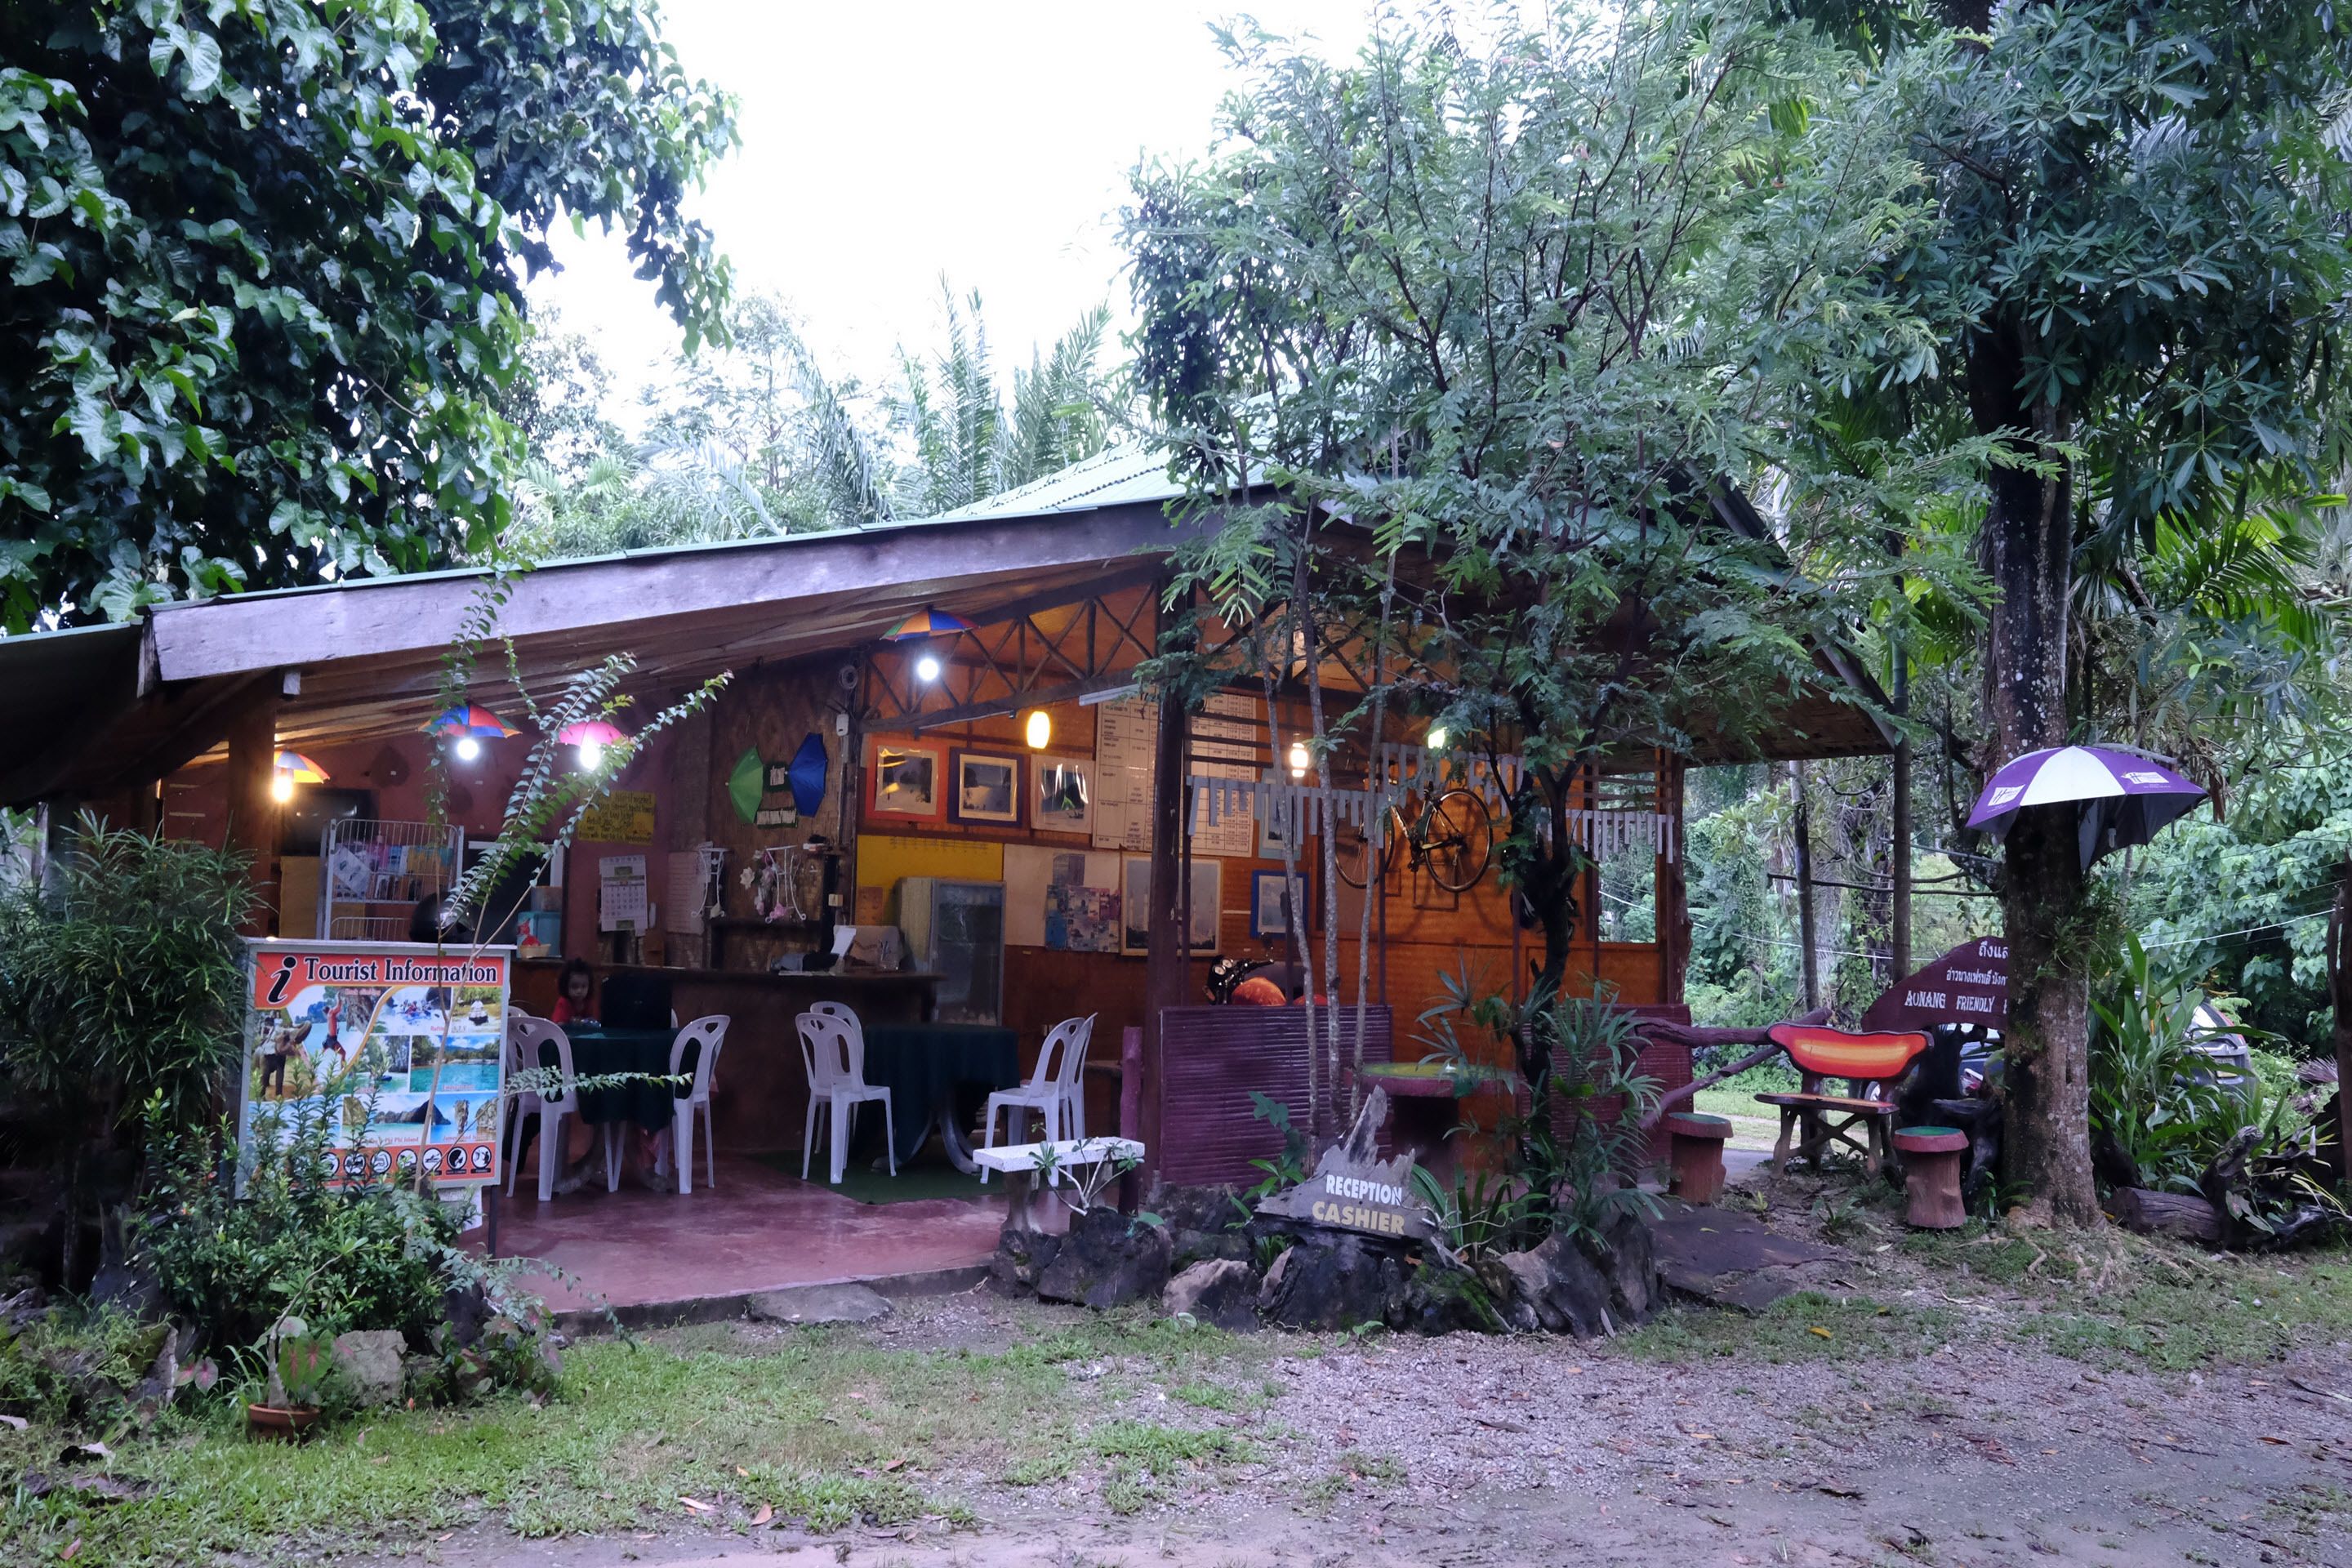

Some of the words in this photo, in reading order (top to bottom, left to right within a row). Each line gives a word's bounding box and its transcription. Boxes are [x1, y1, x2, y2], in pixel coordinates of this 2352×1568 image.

[304, 957, 377, 981] Tourist
[385, 958, 497, 982] Information
[1992, 971, 2008, 986] บังก
[1904, 990, 1946, 1009] AUNANG
[1956, 996, 1996, 1013] FRIENDLY
[1326, 1174, 1402, 1205] RECEPTION
[1312, 1200, 1405, 1235] CASHIER
